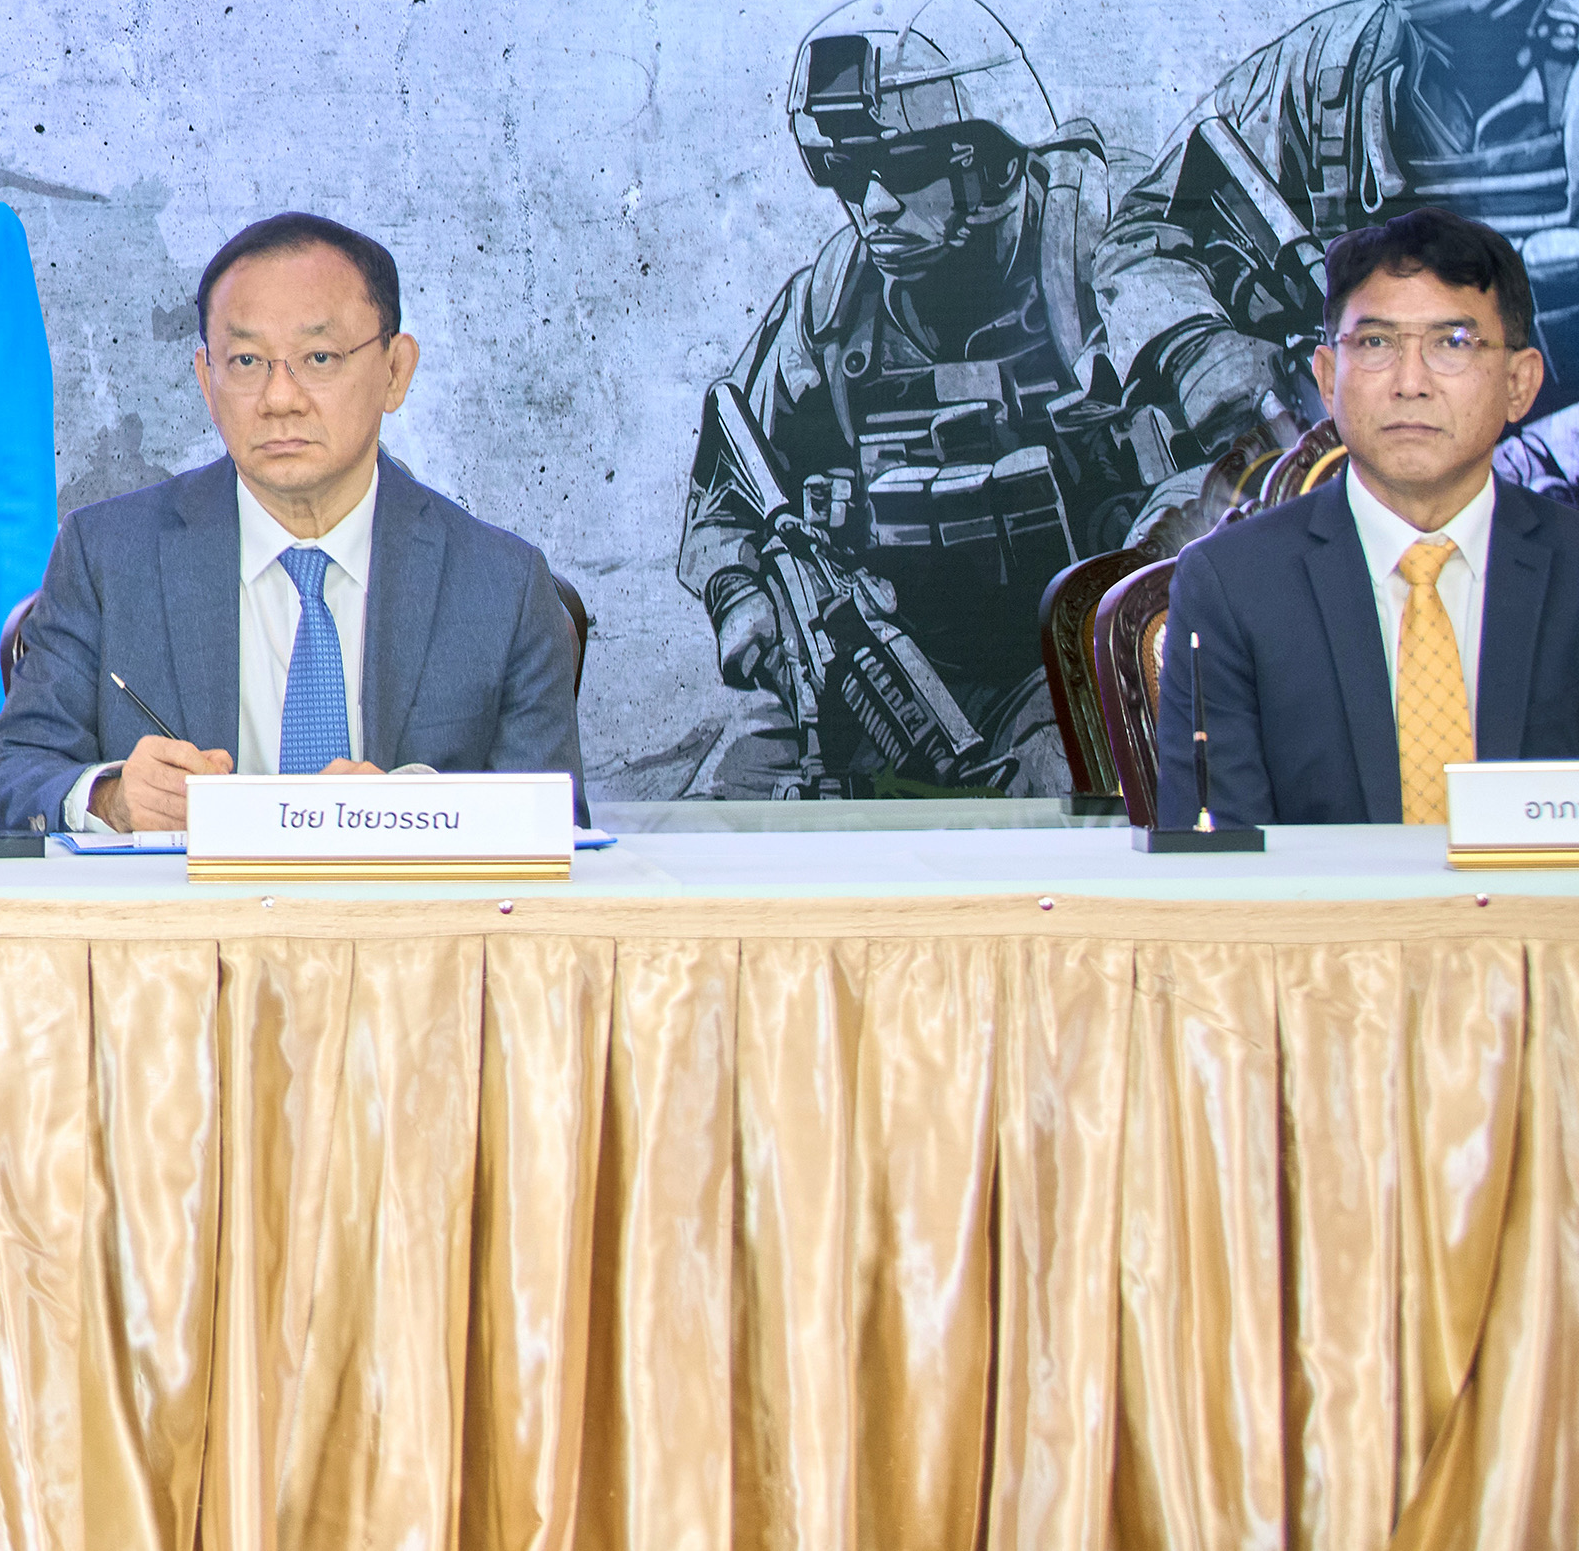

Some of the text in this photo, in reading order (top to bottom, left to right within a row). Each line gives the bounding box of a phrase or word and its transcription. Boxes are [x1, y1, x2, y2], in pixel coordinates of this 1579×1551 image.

[278, 802, 460, 830] ไชย ไชยวรรณ
[1525, 800, 1579, 820] อาภ
